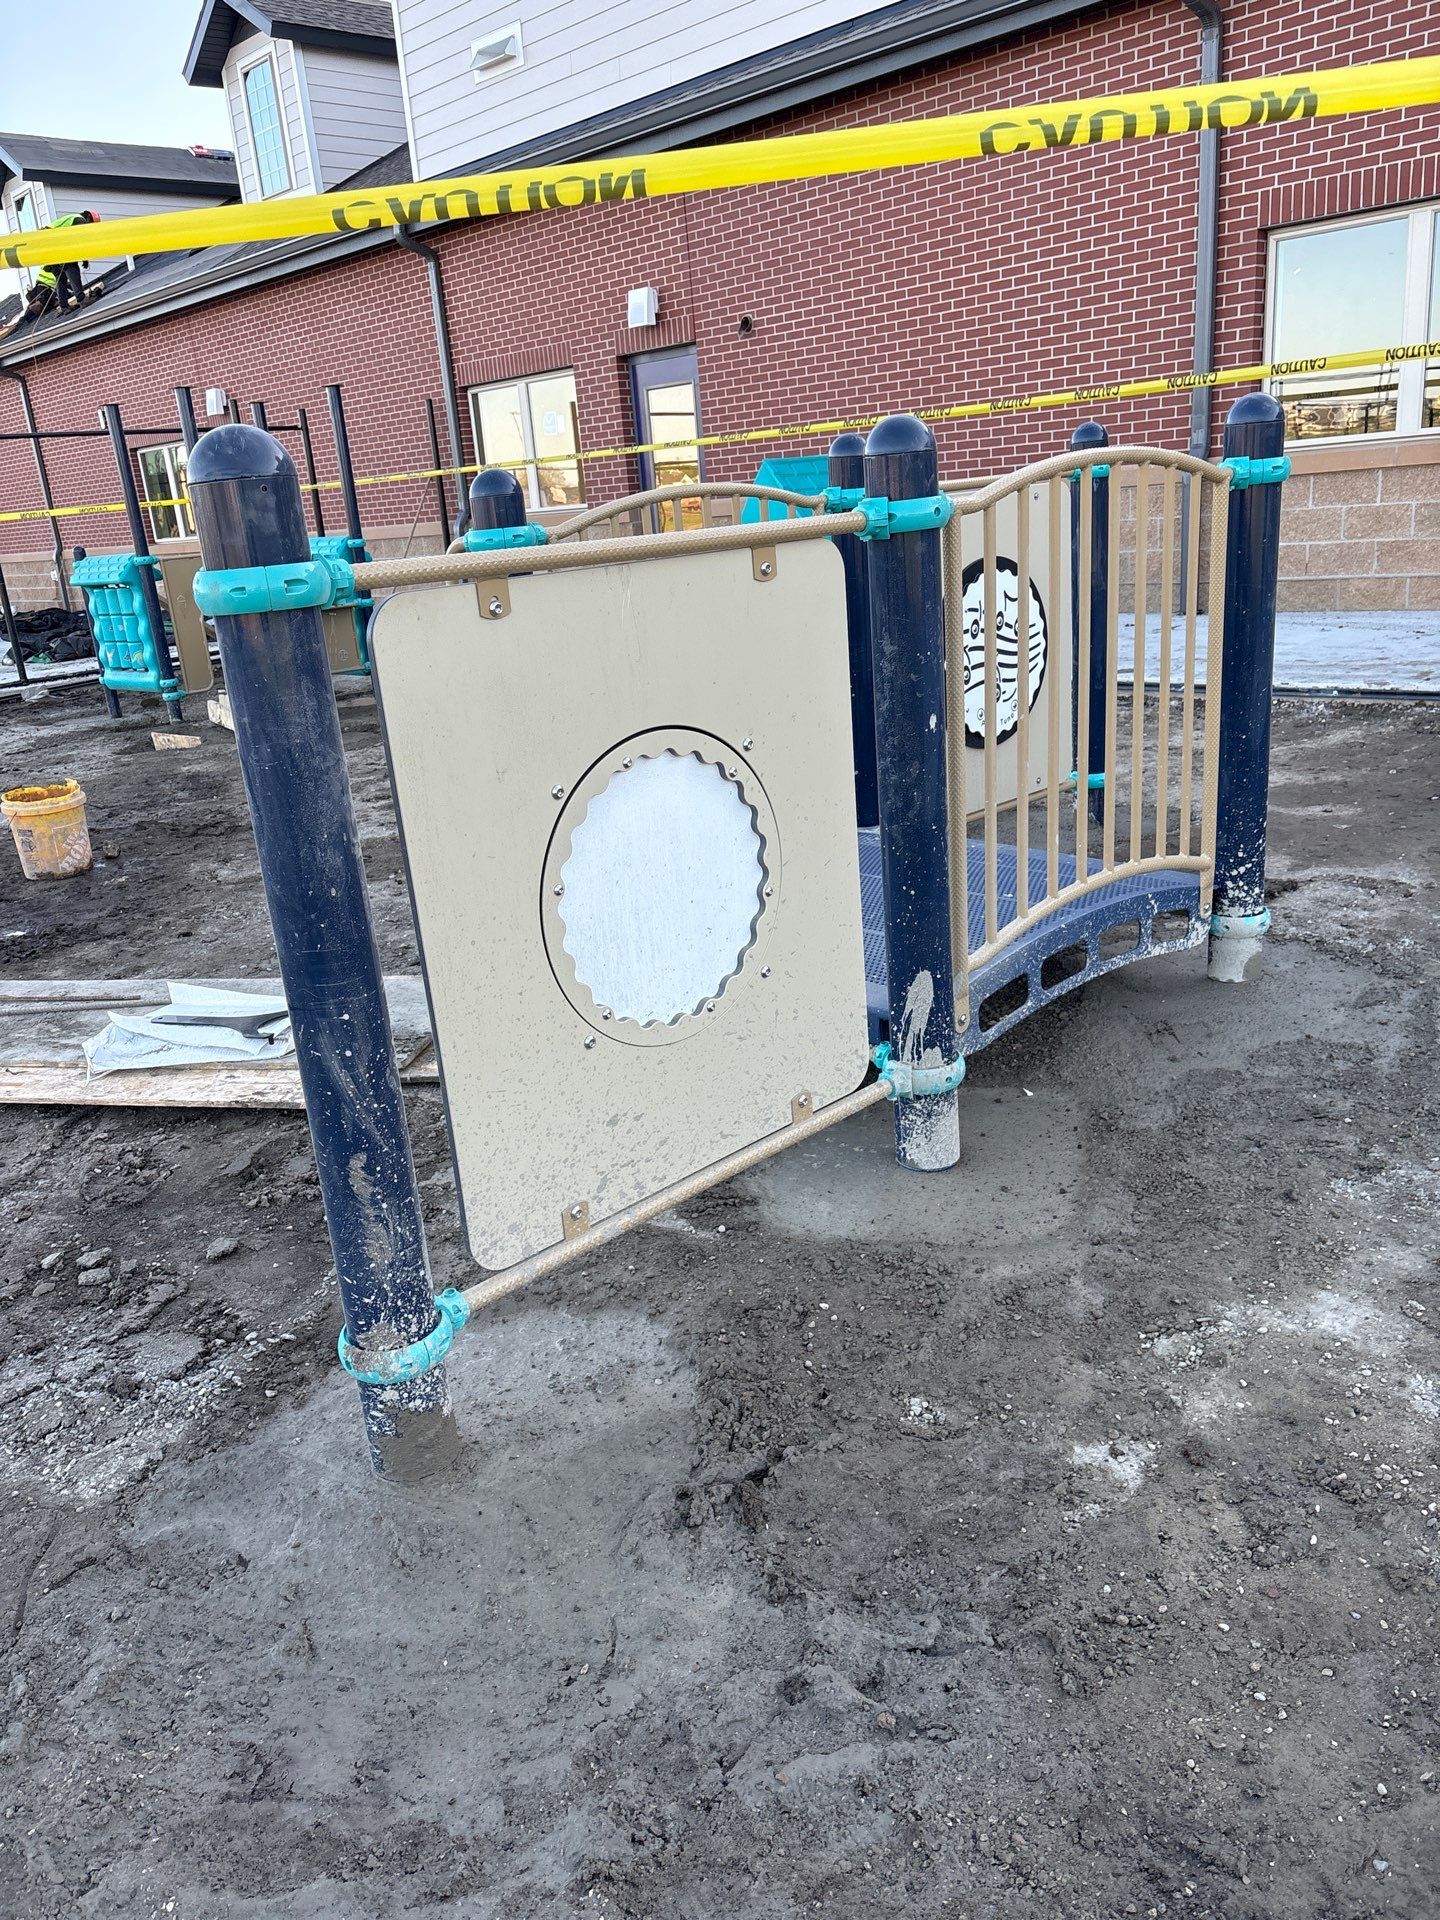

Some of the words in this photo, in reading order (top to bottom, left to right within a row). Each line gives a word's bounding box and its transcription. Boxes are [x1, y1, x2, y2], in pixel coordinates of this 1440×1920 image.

[1271, 358, 1327, 376] CAUTION
[1167, 372, 1218, 389] CAUTION
[1074, 385, 1121, 401] CAUTION
[990, 396, 1032, 411] CAUTION
[914, 407, 952, 419] CAUTION
[843, 416, 879, 428] CAUTION
[778, 424, 812, 435] CAUTION
[718, 432, 749, 442] CAUTION
